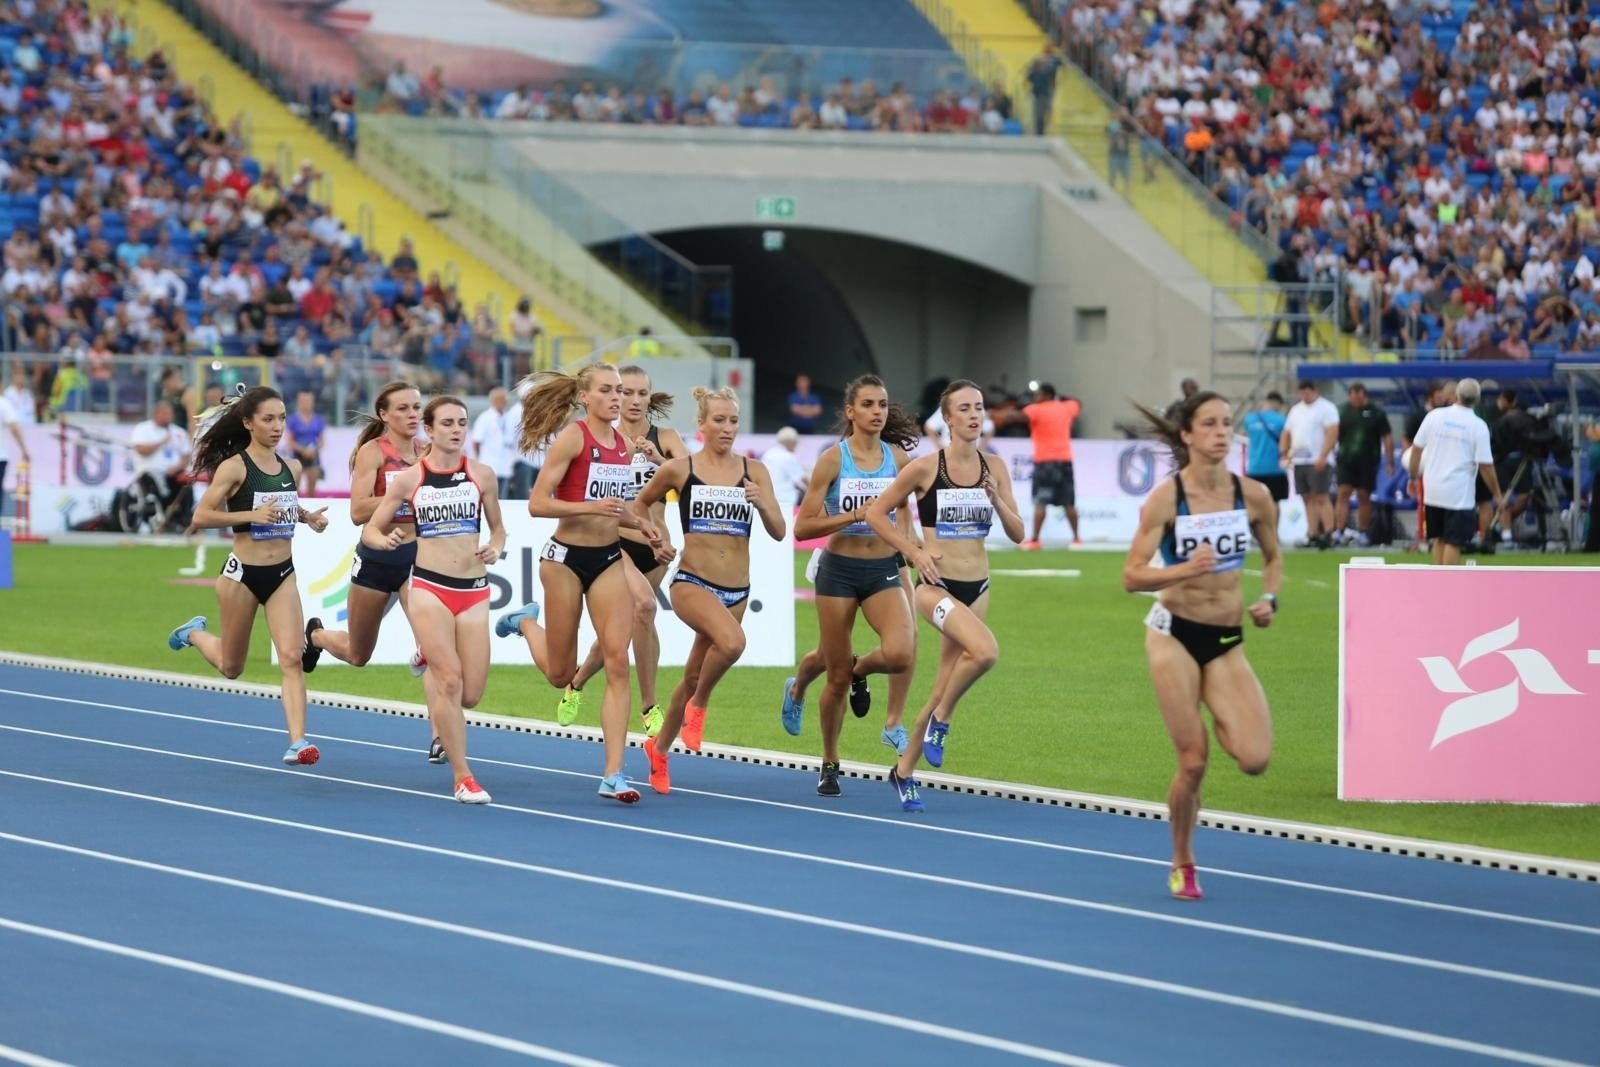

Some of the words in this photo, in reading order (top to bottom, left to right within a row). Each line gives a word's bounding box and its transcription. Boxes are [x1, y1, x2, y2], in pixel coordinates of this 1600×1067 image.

[418, 502, 476, 523] MCDONALD
[692, 501, 751, 522] BROWN
[547, 543, 556, 559] 6
[226, 558, 238, 573] 9
[936, 605, 945, 619] 3
